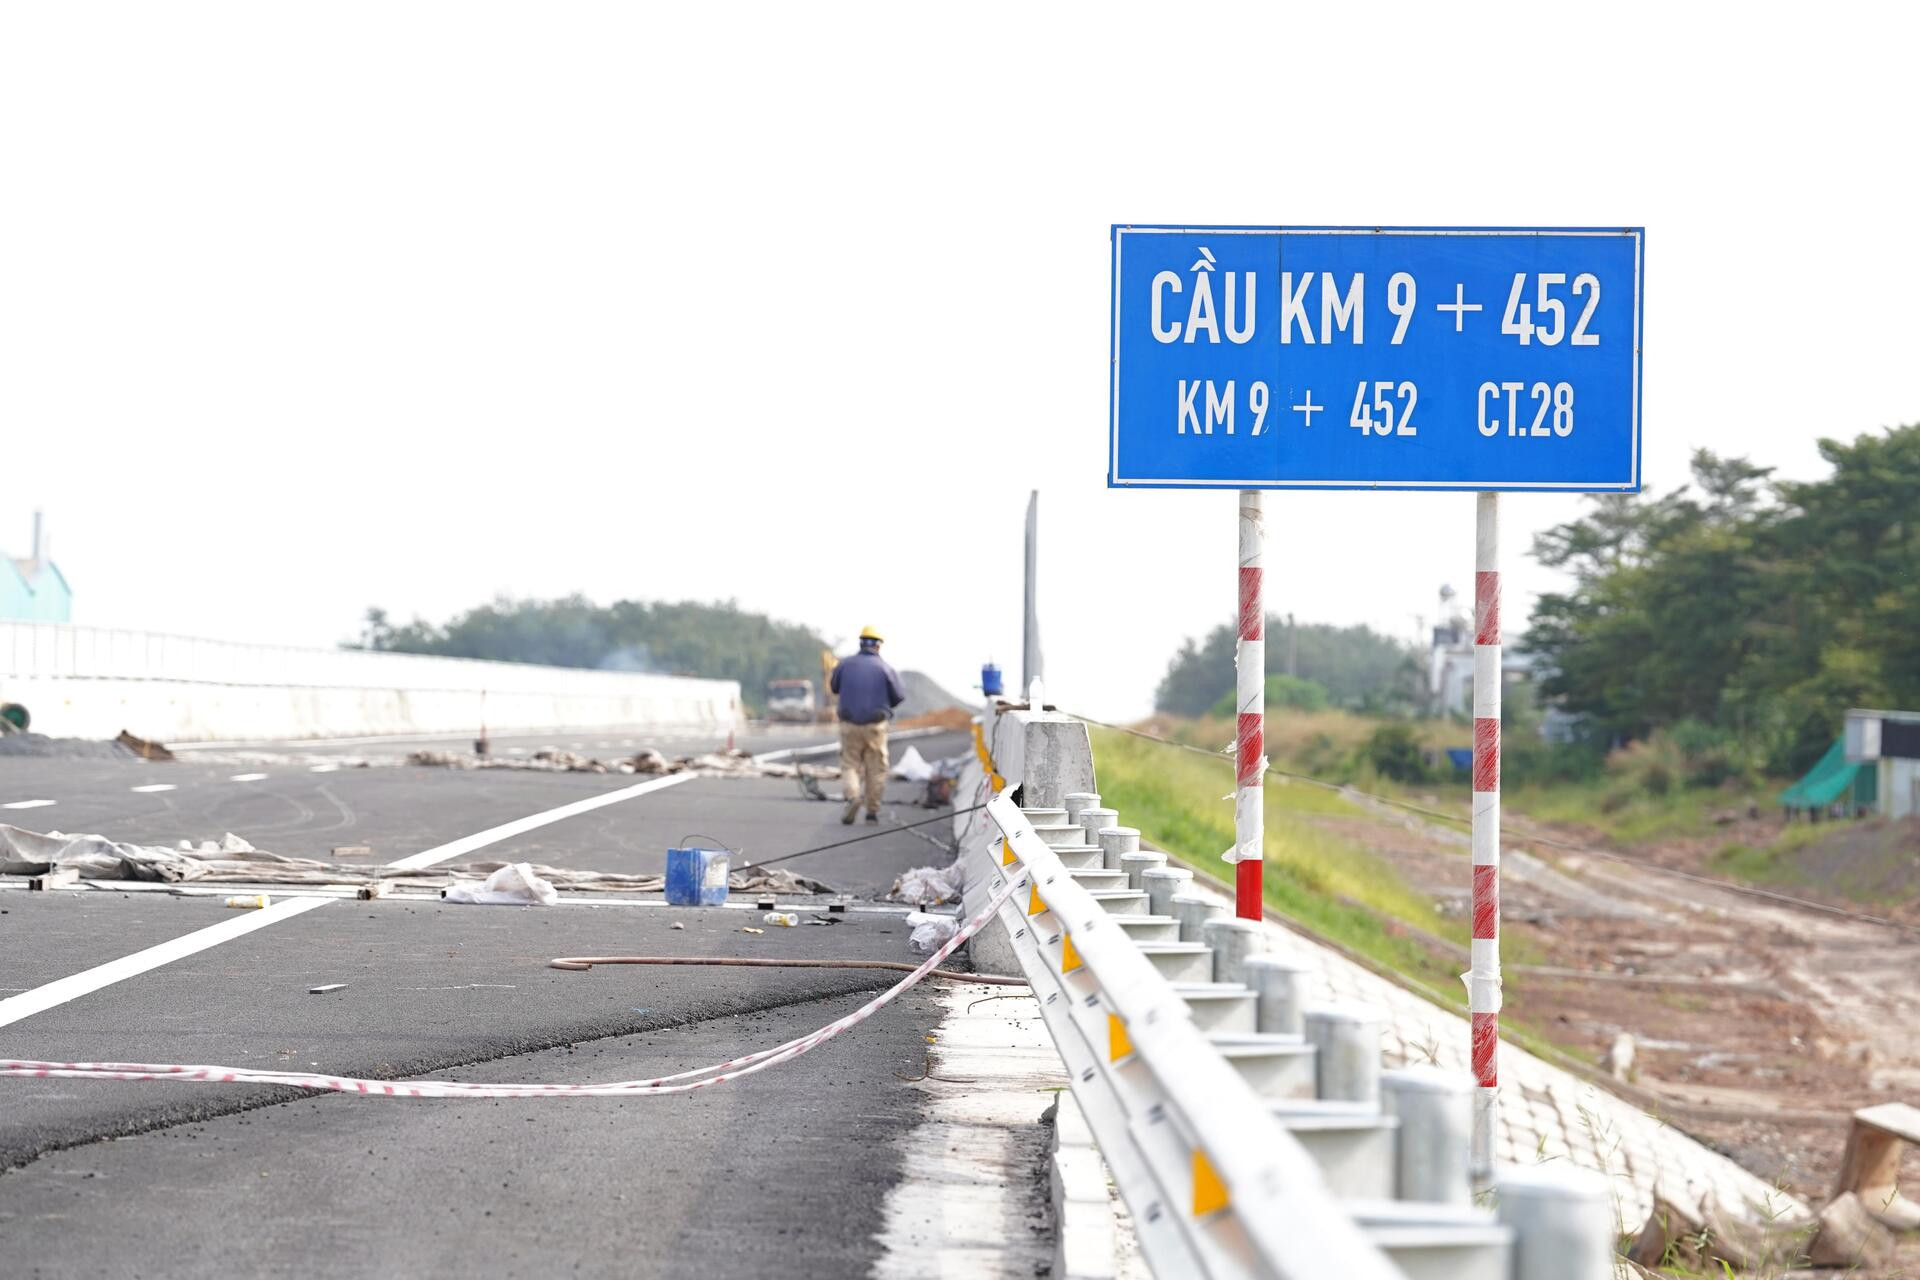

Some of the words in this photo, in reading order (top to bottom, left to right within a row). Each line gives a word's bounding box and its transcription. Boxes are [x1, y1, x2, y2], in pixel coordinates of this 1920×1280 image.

[1151, 247, 1256, 344] CẦU
[1281, 272, 1364, 345] KM
[1387, 272, 1417, 345] 9
[1436, 283, 1483, 332] +
[1501, 272, 1601, 346] 452
[1178, 380, 1235, 435] KM
[1249, 381, 1269, 436] 9
[1293, 390, 1324, 427] +
[1350, 381, 1418, 436] 452
[1478, 381, 1575, 437] CT.28
